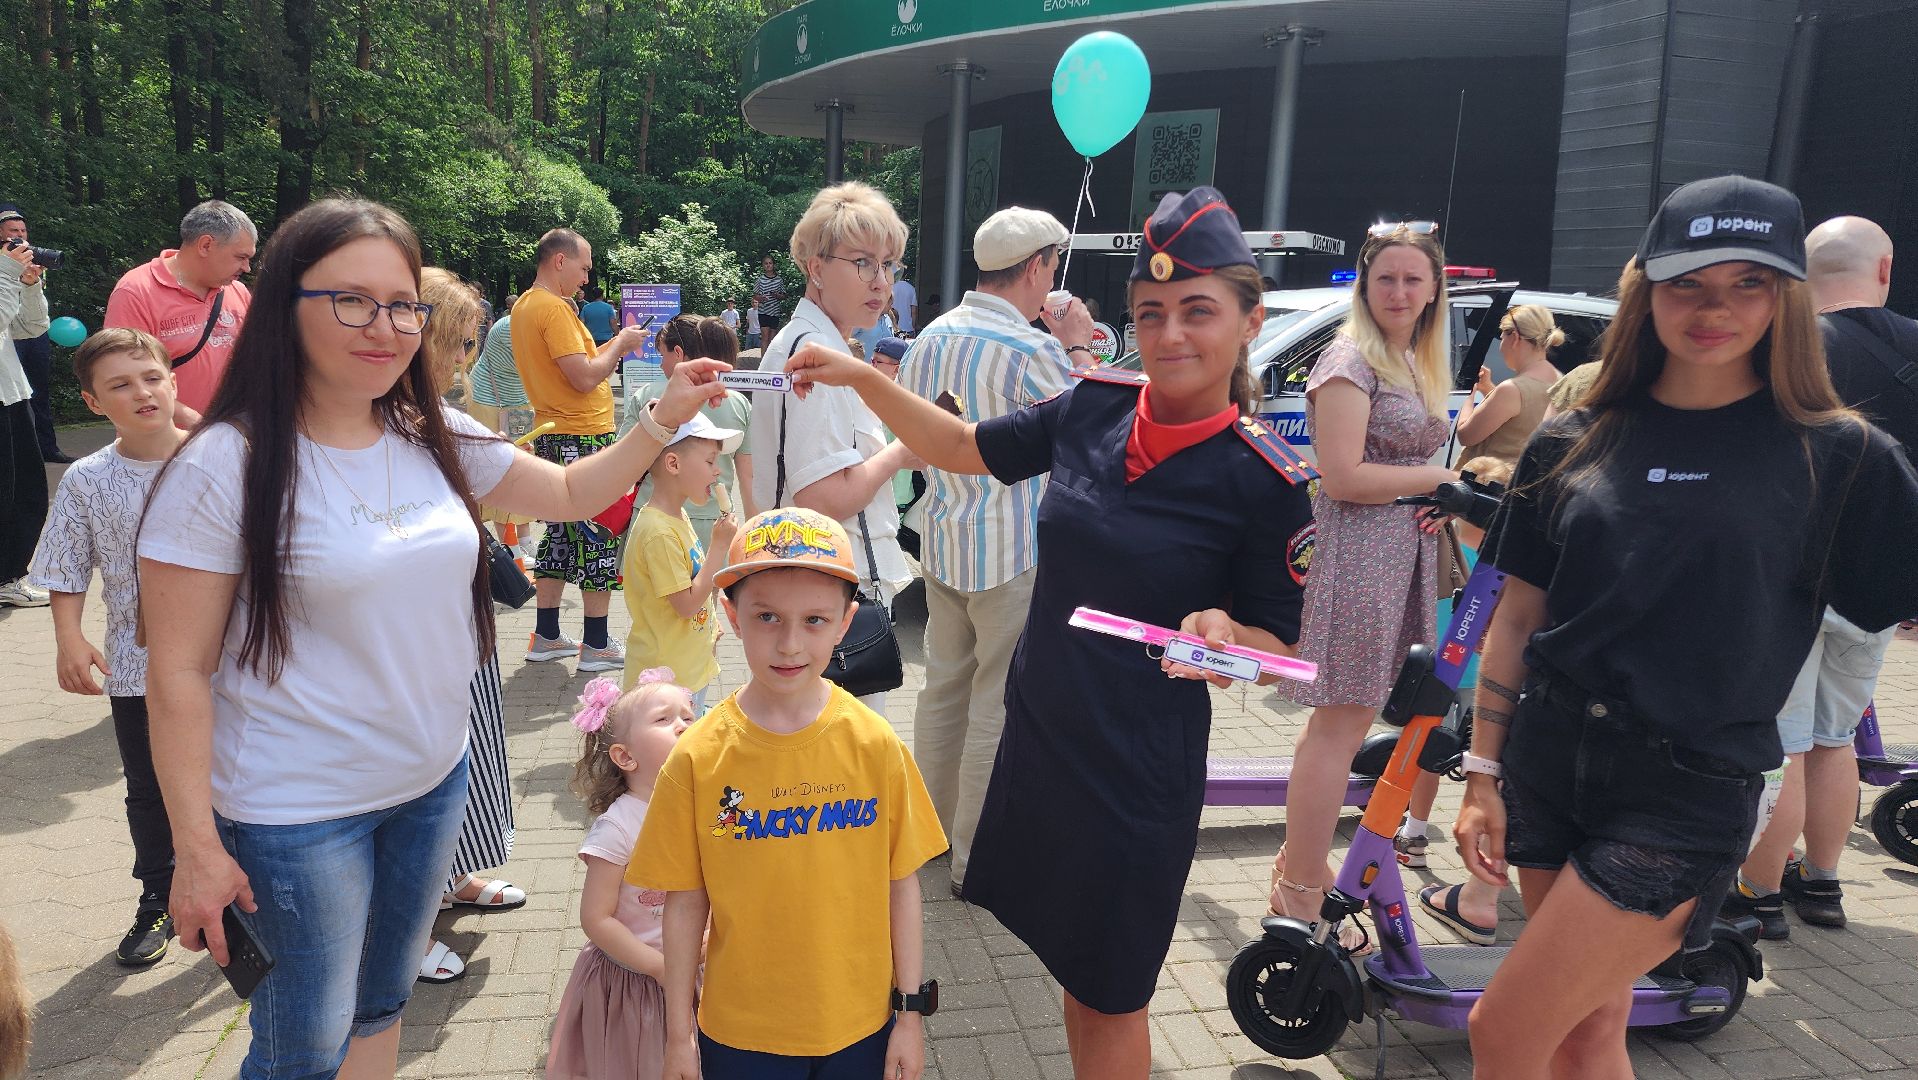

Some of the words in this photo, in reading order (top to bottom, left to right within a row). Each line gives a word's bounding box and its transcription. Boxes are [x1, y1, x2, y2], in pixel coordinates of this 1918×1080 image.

[891, 22, 923, 37] ЁЛОЧКИ
[1717, 217, 1773, 234] юрент
[160, 317, 180, 330] SURF
[181, 314, 197, 327] CITY
[1455, 595, 1482, 641] ЮРЕНТ
[1205, 656, 1235, 669] юрент
[734, 803, 819, 841] MICKY
[816, 797, 879, 833] MAUS
